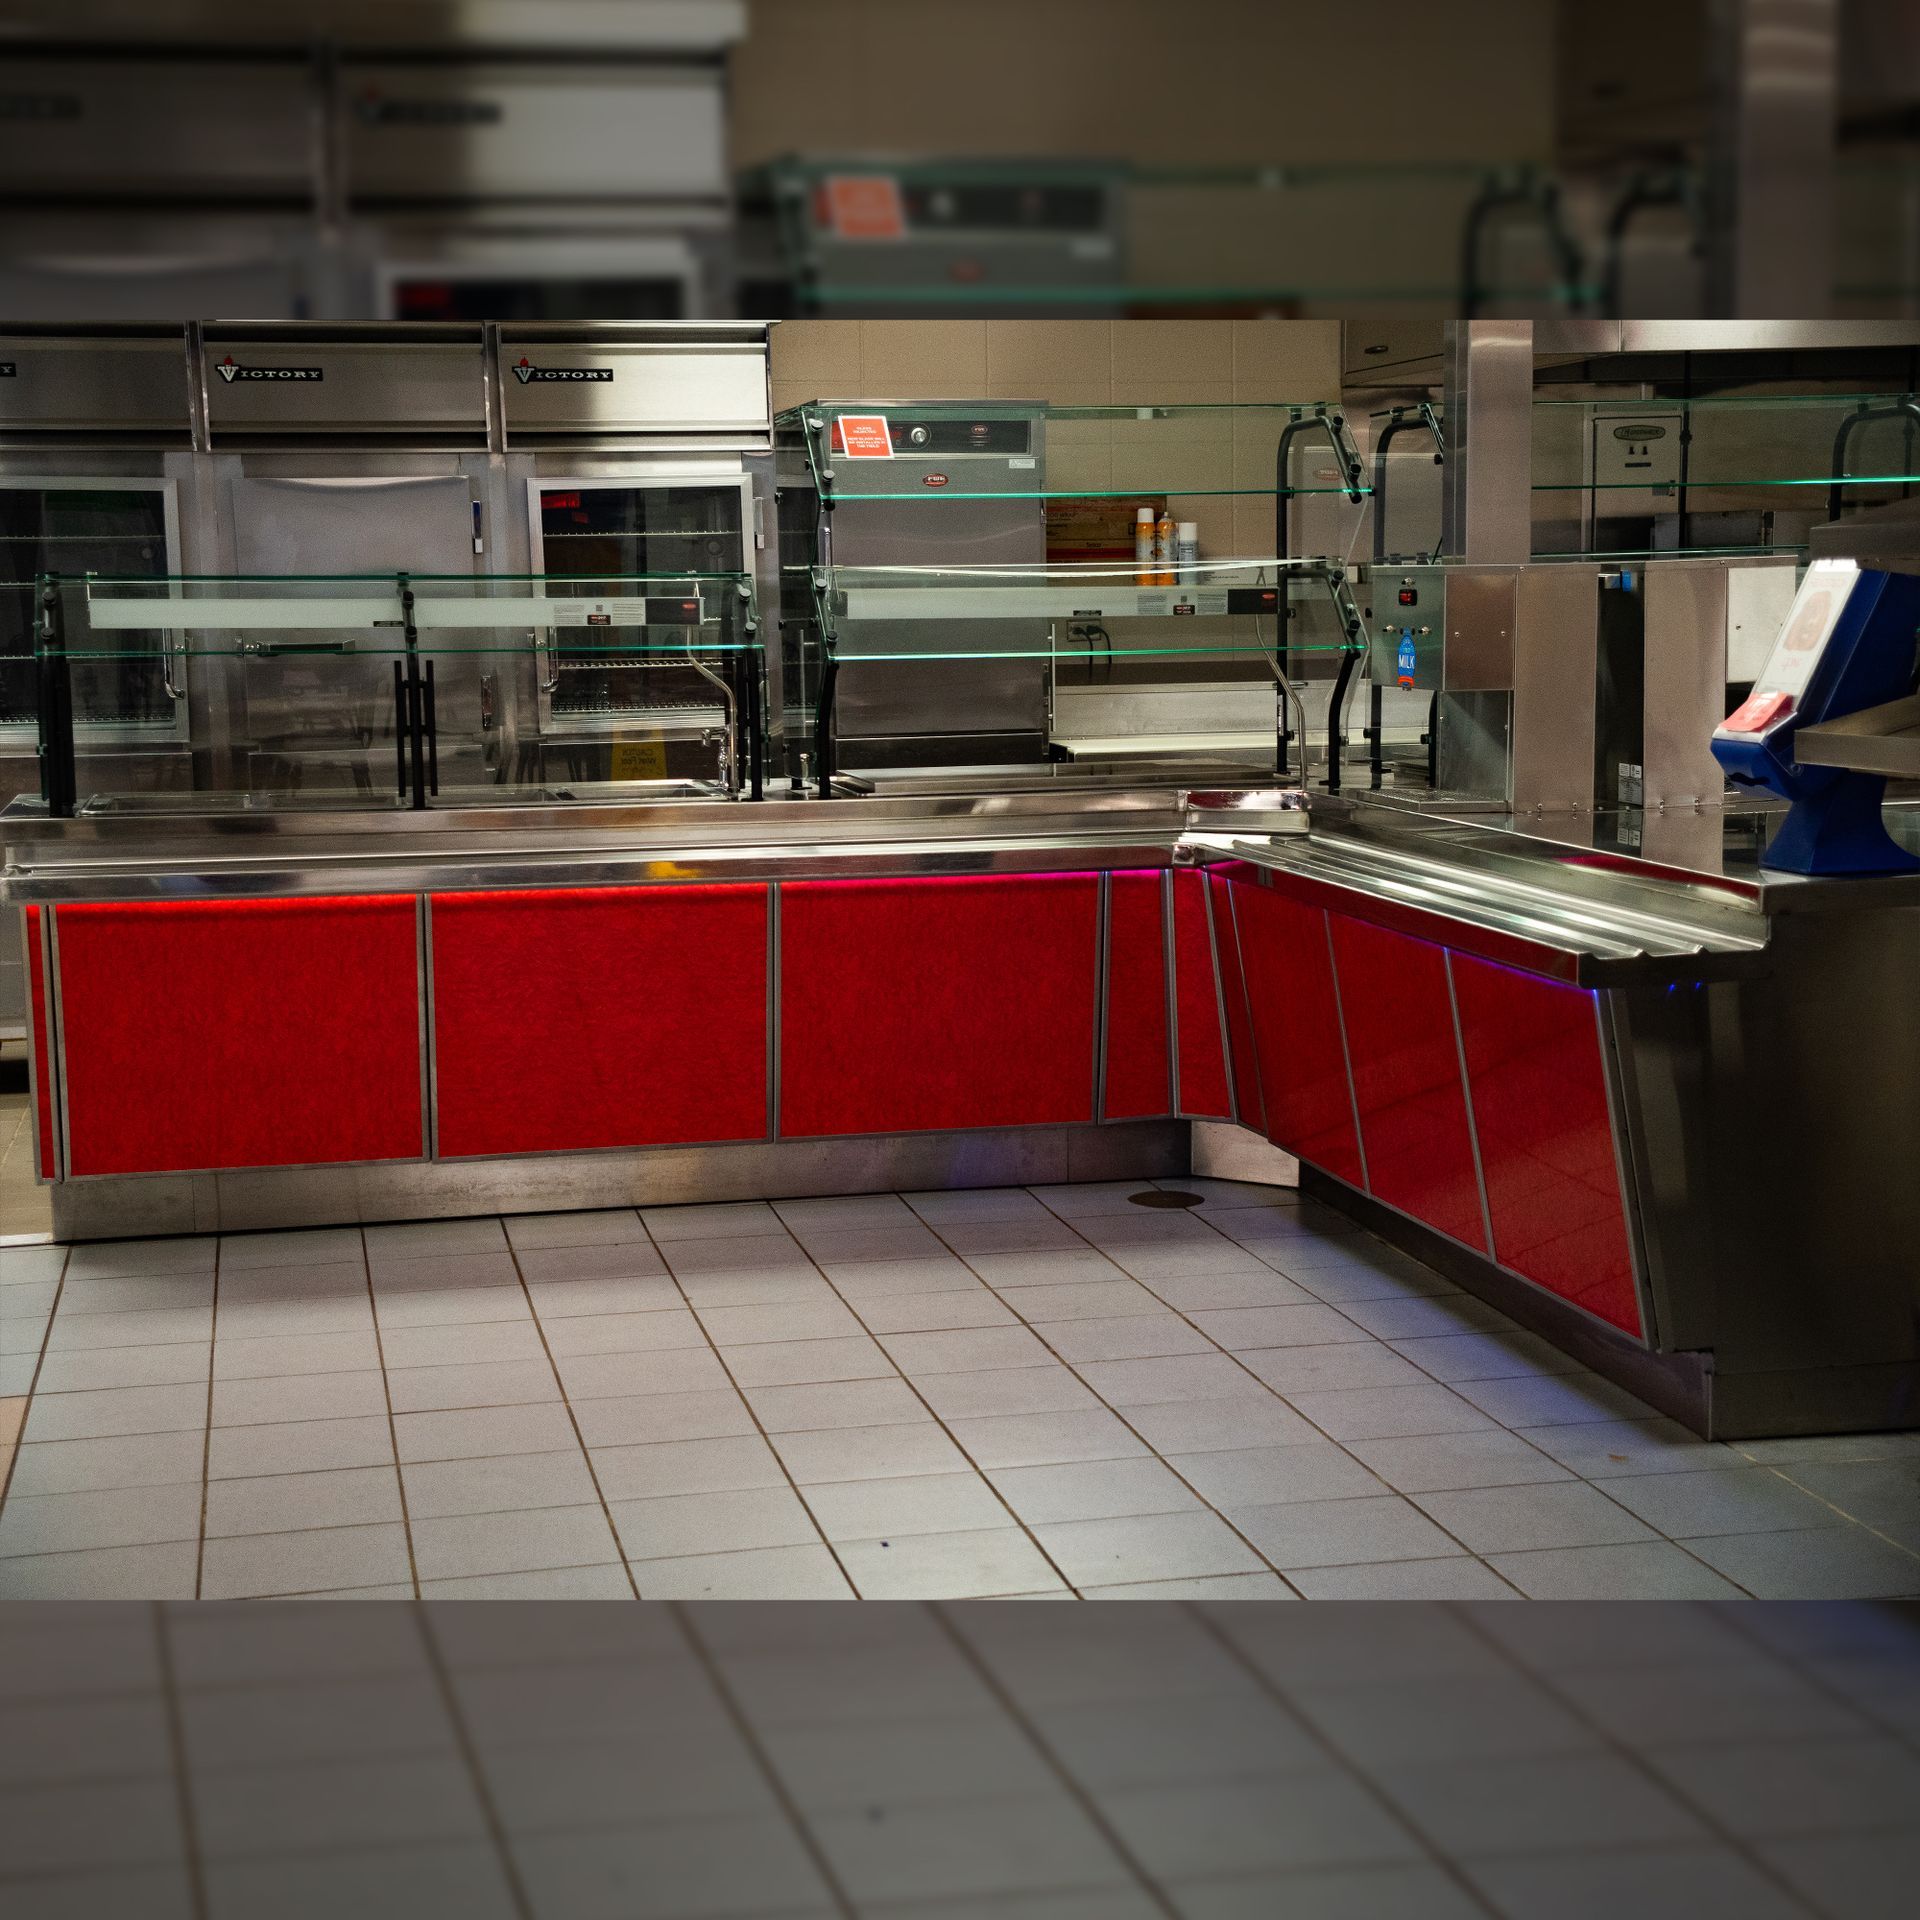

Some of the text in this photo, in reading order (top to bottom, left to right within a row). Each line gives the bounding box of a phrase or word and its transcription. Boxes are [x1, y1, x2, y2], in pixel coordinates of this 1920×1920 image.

[217, 366, 320, 382] VICTORY
[513, 367, 610, 383] VICTORY
[1398, 654, 1415, 669] MILK
